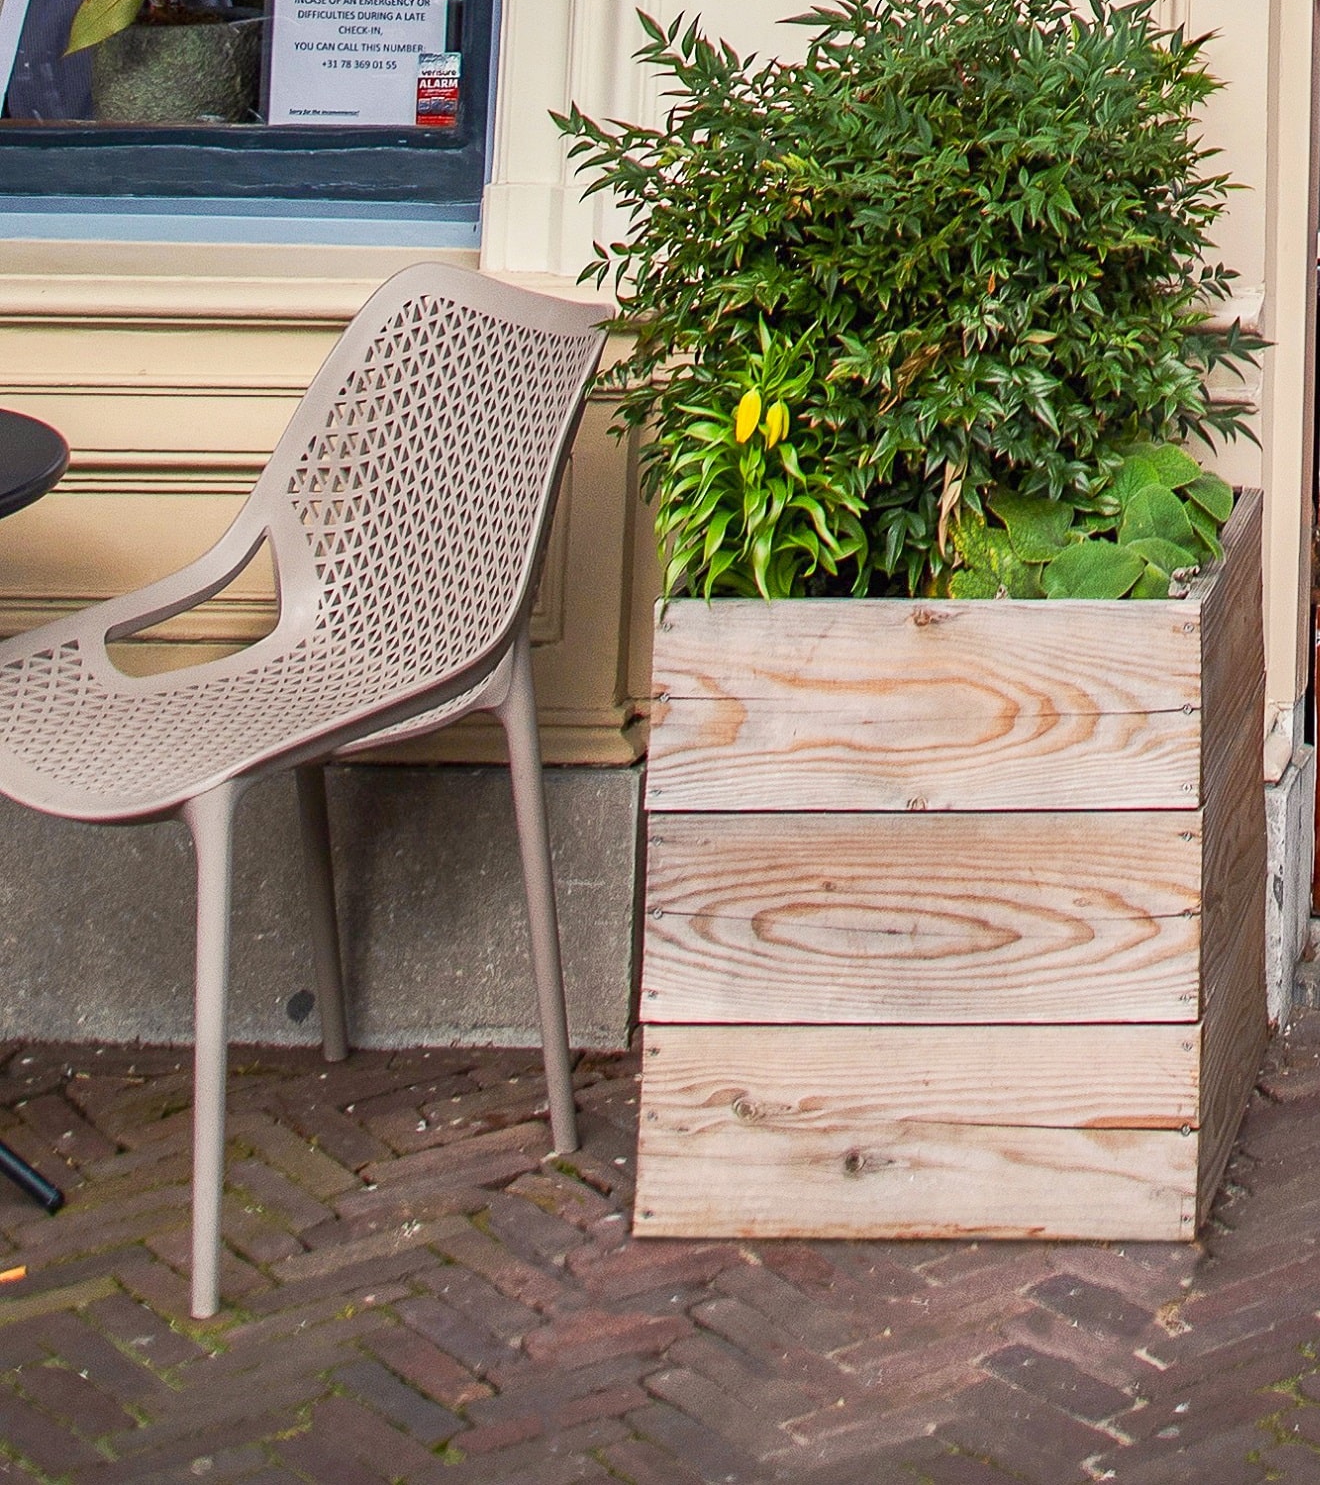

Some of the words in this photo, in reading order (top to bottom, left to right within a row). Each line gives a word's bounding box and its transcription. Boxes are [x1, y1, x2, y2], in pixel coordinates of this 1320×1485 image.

[297, 10, 355, 20] DIFFICULTIES
[357, 12, 394, 21] DURING
[395, 12, 402, 21] A
[404, 12, 426, 22] LATE
[338, 25, 384, 36] CHECK-IN,
[294, 42, 314, 51] YOU
[316, 42, 335, 51] CAN
[337, 42, 359, 52] CALL
[361, 43, 381, 52] THIS
[321, 59, 337, 68] +31
[341, 60, 352, 68] 78
[354, 60, 370, 69] 369
[372, 60, 383, 69] 01
[385, 60, 397, 69] 55
[419, 78, 458, 89] ALARM
